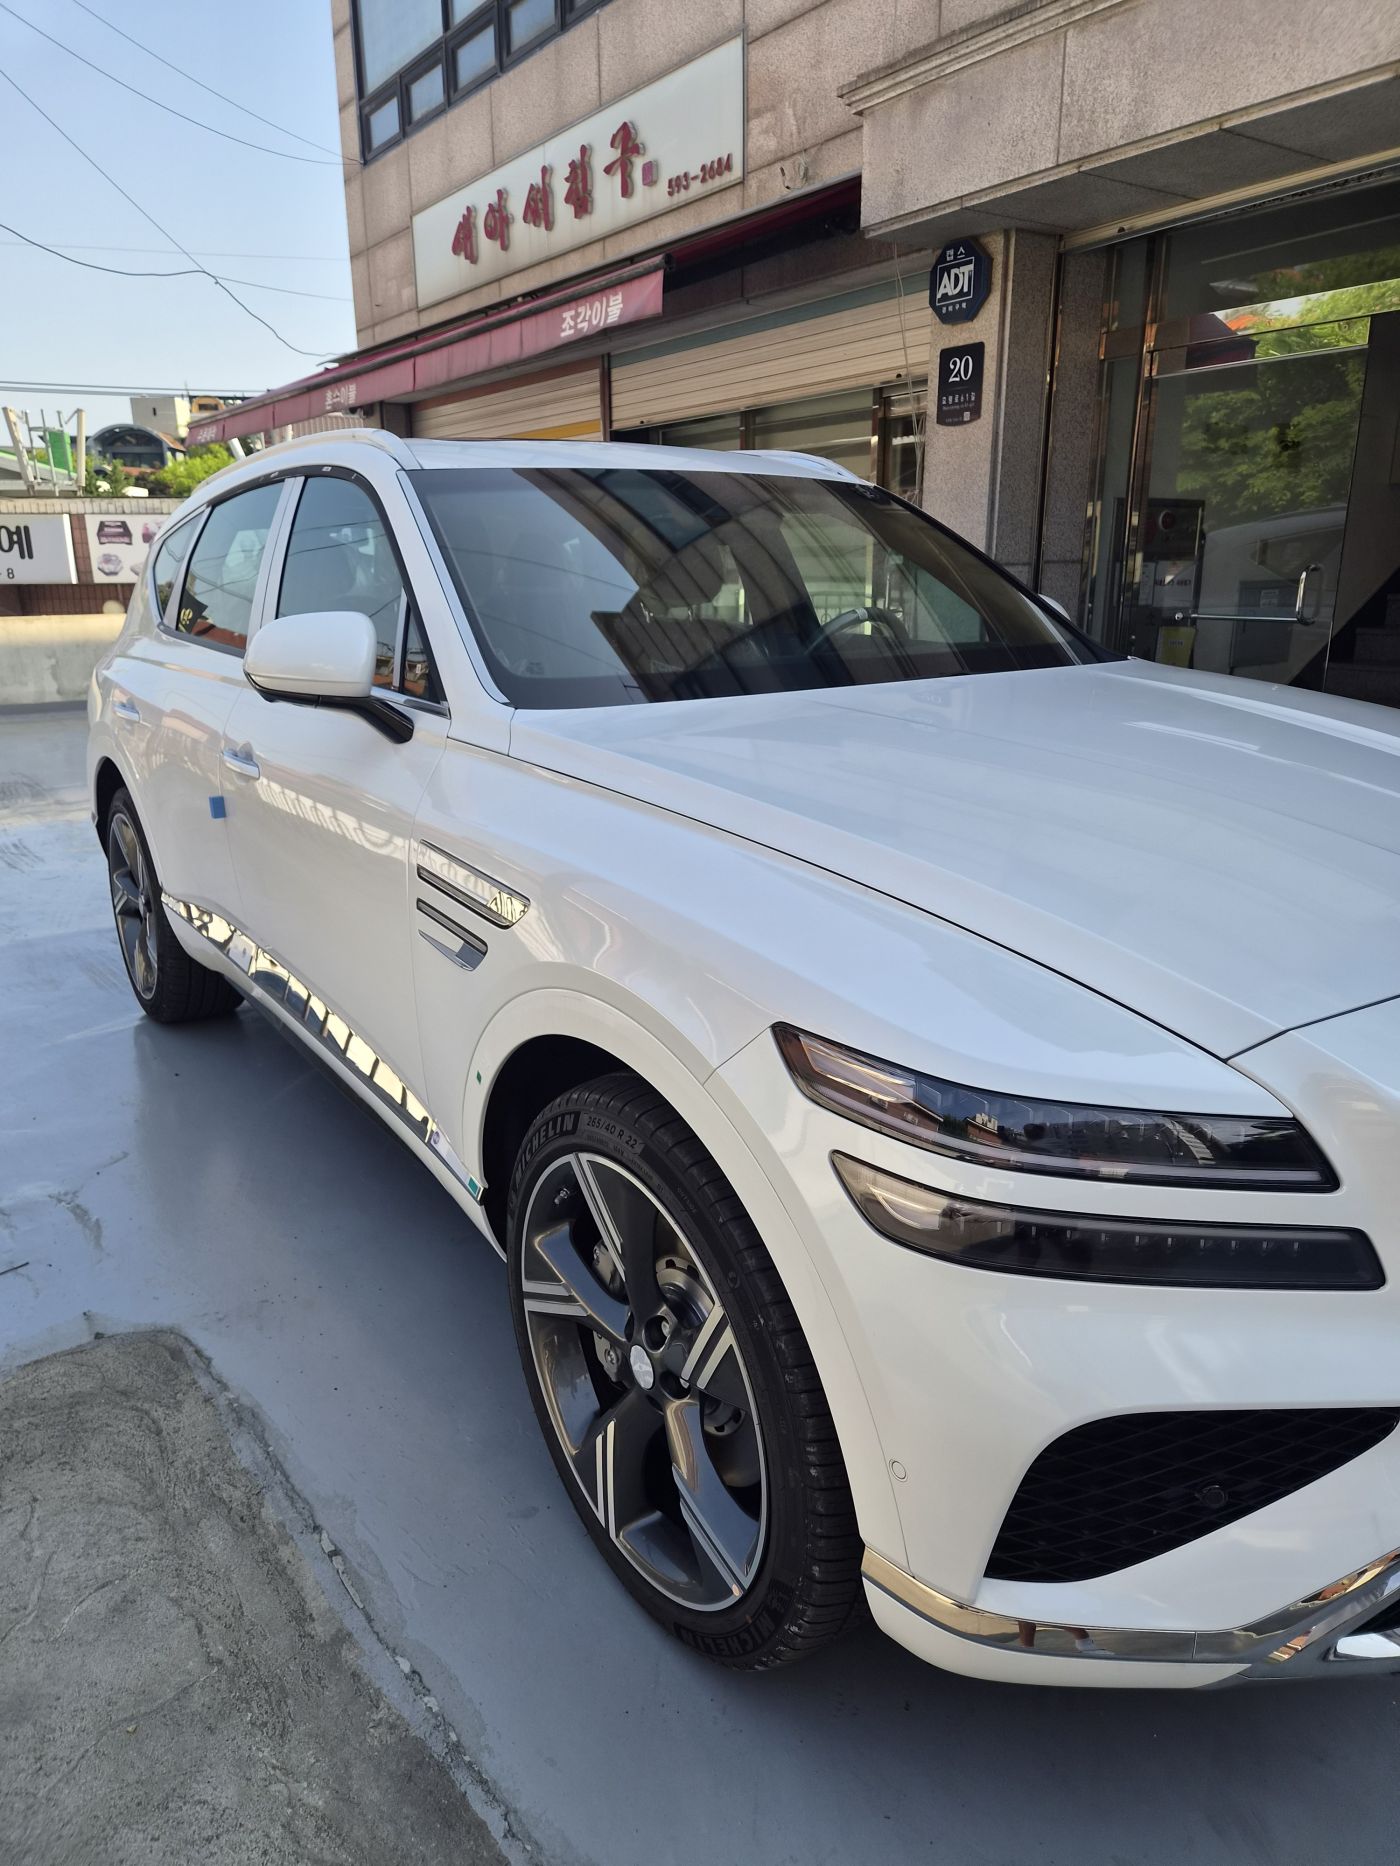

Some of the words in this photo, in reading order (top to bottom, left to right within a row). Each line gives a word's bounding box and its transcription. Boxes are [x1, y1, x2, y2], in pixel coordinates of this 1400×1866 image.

[937, 263, 974, 299] ADT
[560, 291, 624, 338] 조각이불
[948, 355, 974, 383] 20
[617, 1129, 625, 1141] R
[625, 1135, 639, 1149] 22
